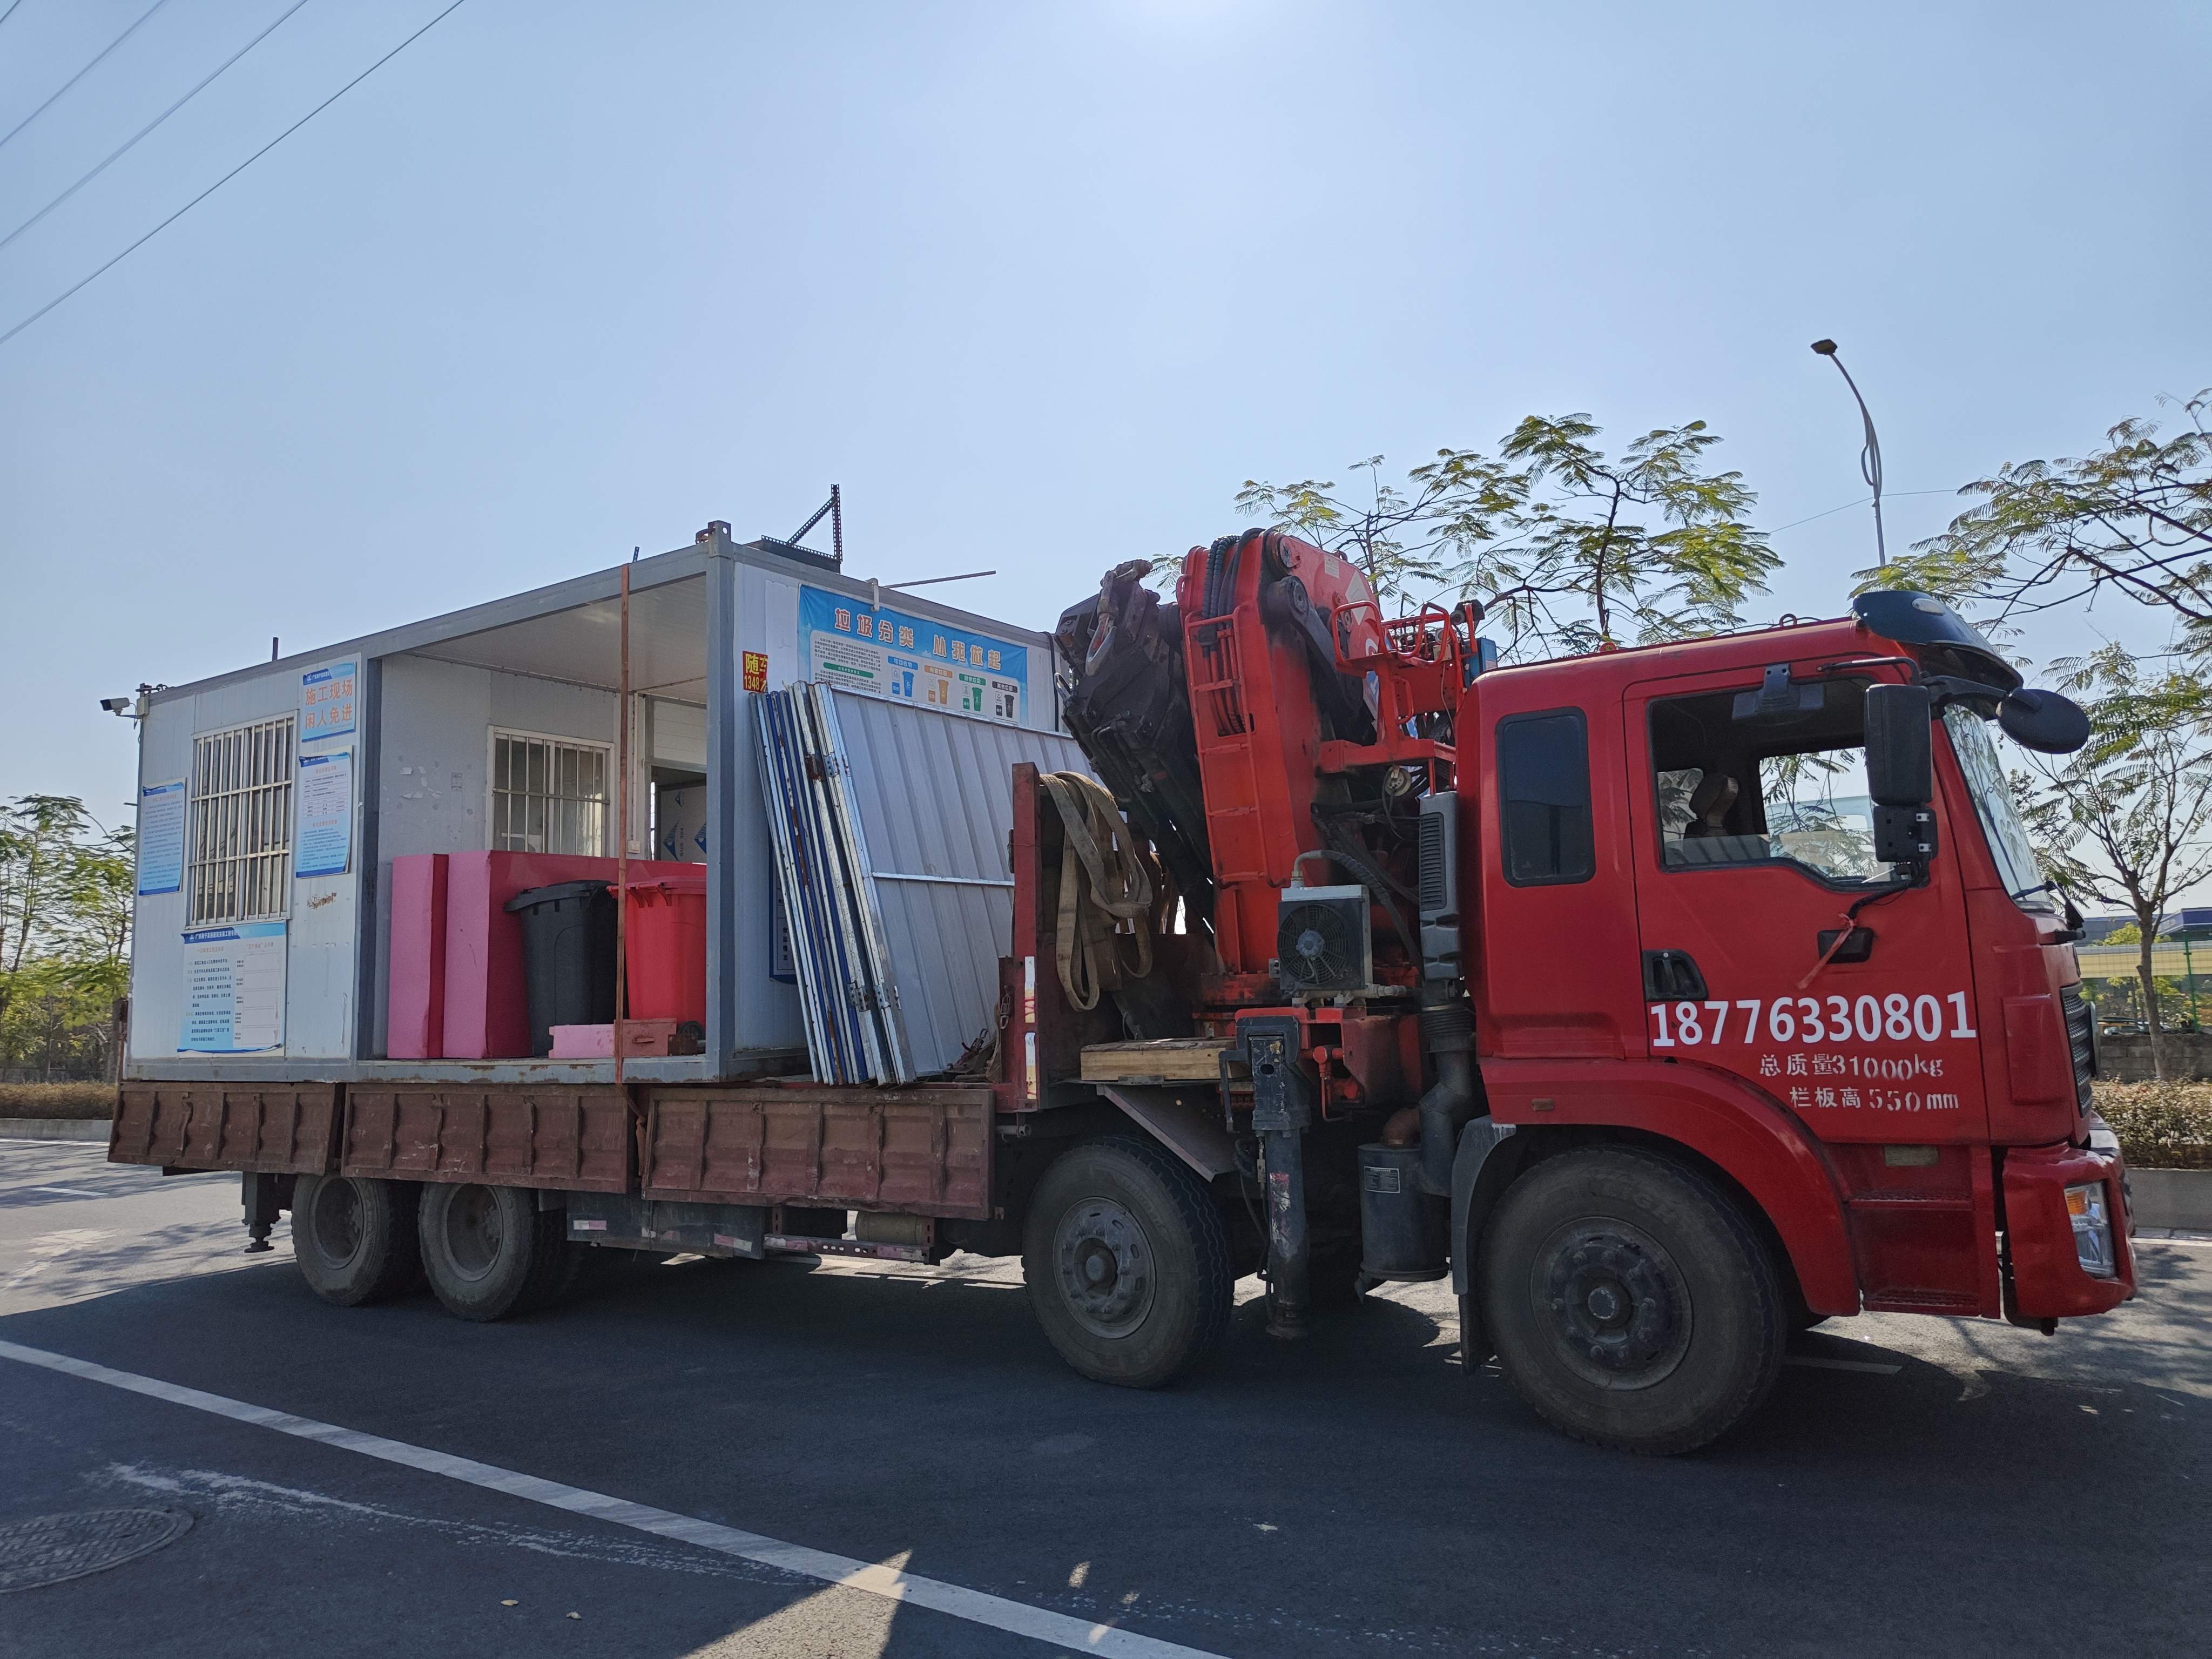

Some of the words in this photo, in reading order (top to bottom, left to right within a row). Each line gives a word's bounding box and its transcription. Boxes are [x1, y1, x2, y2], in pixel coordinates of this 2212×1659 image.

[834, 608, 915, 650] 垃圾分类
[933, 634, 1002, 671] 从我做起
[305, 678, 353, 706] 施工现场
[305, 703, 353, 730] 闲人免进
[1650, 990, 1977, 1047] 18776330801
